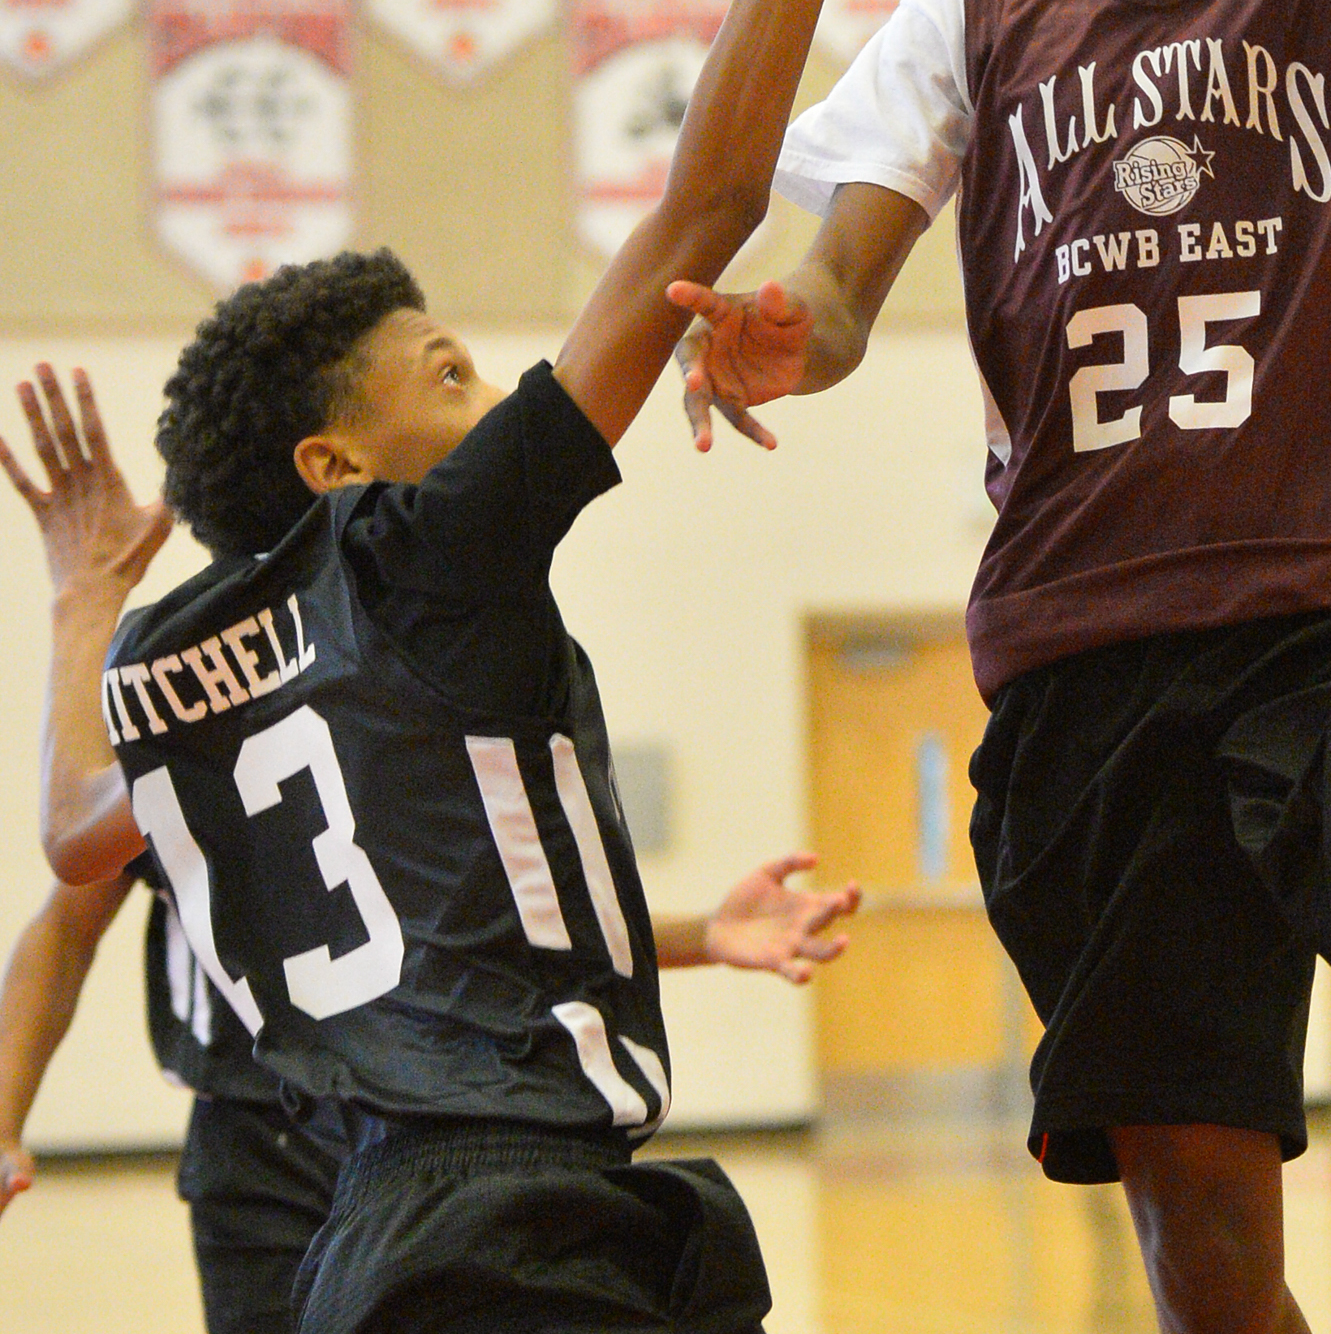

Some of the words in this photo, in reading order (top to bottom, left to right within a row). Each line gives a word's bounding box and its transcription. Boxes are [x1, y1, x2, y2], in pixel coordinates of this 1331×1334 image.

[1008, 61, 1118, 263] ALL
[1115, 159, 1188, 188] Rising
[1139, 177, 1198, 208] Stars
[1055, 229, 1160, 284] BCWB
[1177, 216, 1283, 262] EAST
[1065, 290, 1261, 453] 25
[132, 704, 405, 1039] 13
